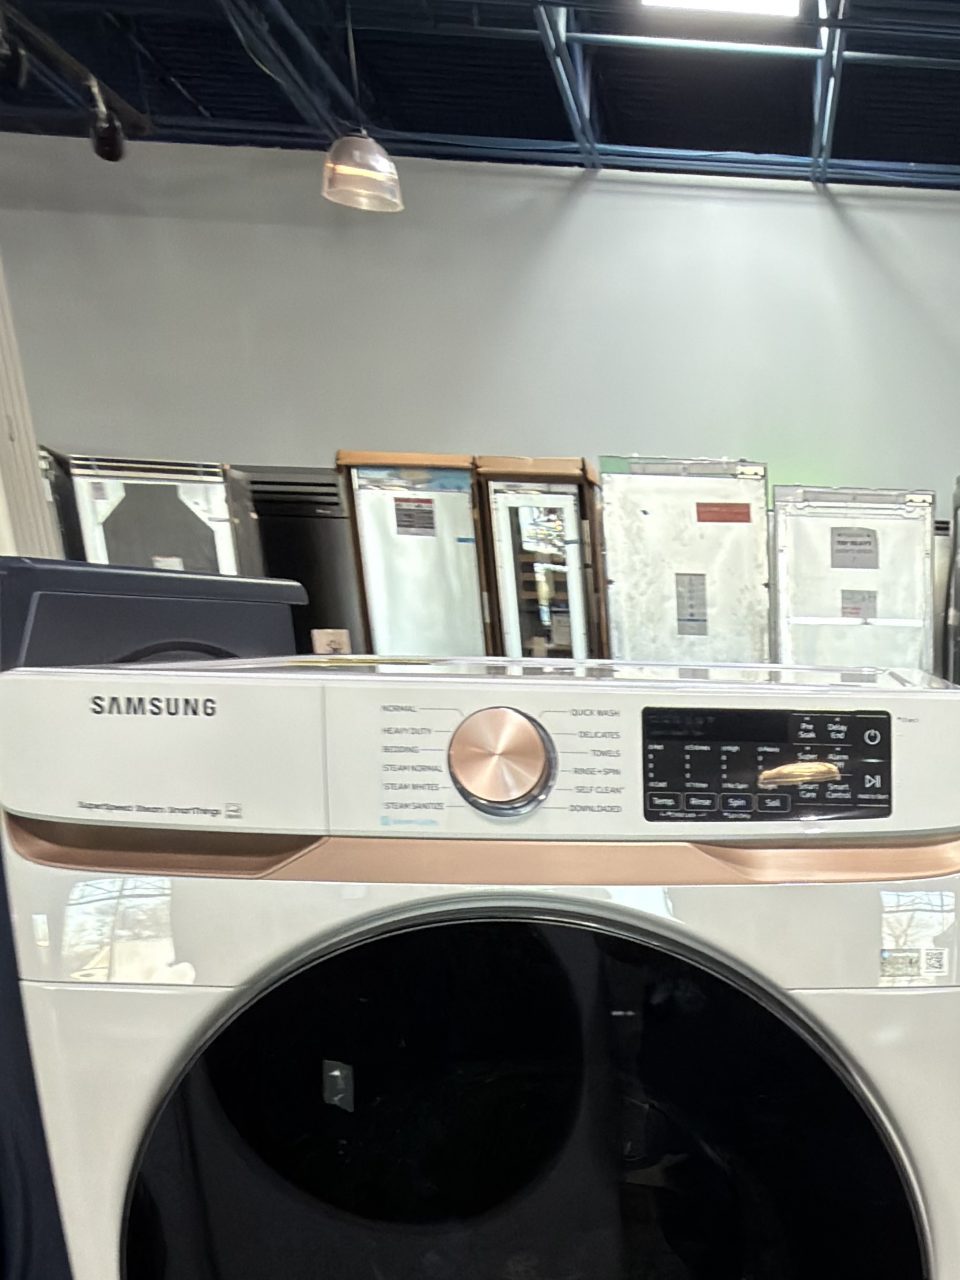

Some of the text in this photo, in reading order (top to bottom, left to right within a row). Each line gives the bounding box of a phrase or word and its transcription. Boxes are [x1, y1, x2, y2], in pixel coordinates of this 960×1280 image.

[91, 696, 216, 716] SAMSUNG
[382, 704, 417, 712] NORMAL
[571, 708, 621, 717] QUICK WASH
[382, 727, 432, 735] HEAVY DUTY
[578, 730, 621, 739] DELICATES
[383, 782, 410, 791] STEAM
